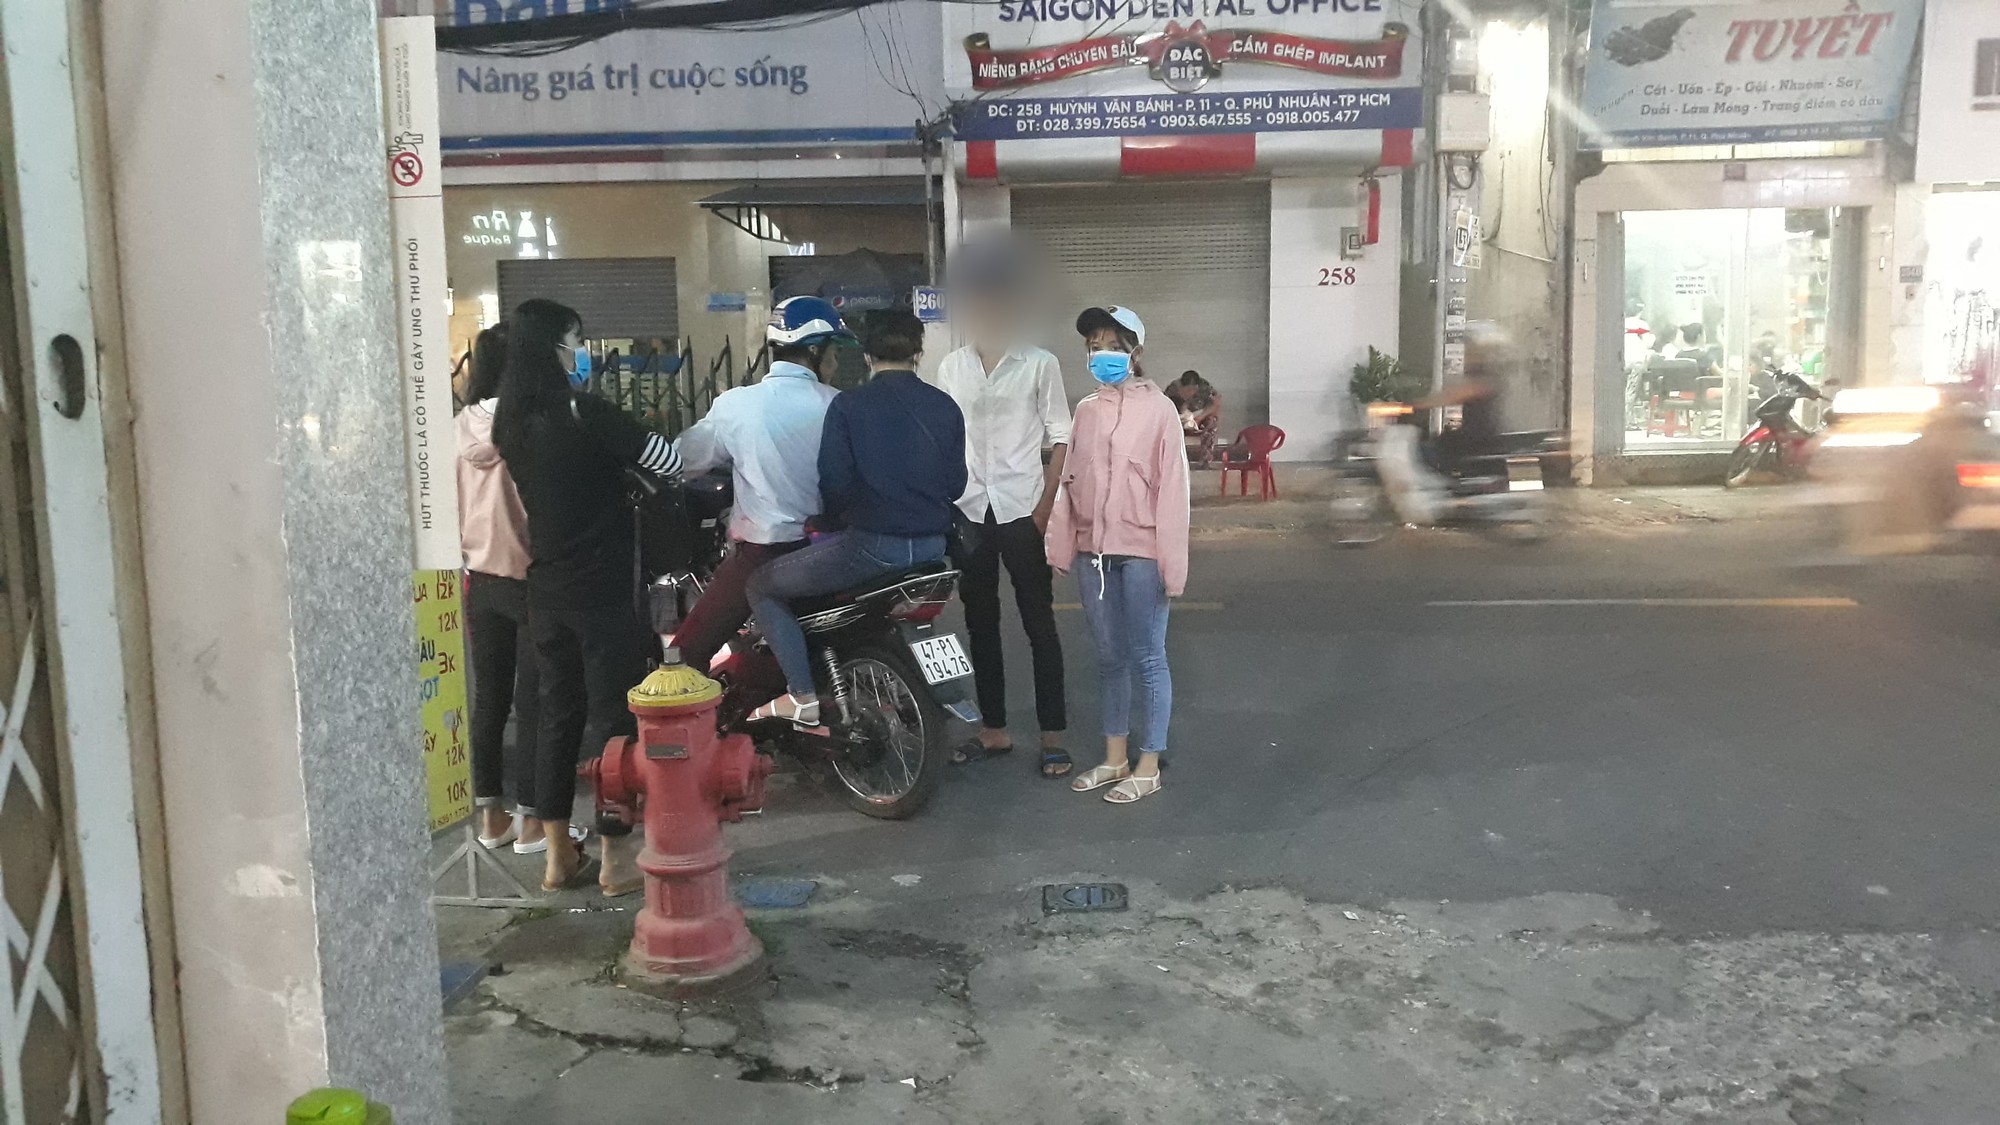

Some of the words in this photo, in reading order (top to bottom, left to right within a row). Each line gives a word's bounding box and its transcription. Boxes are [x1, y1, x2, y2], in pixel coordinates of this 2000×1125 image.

[1111, 40, 1137, 59] SÂU
[1170, 46, 1203, 63] ĐẶC
[1273, 44, 1315, 61] GHÉP
[1318, 52, 1388, 69] IMPLANT
[457, 66, 540, 101] Nâng
[548, 63, 595, 101] giá
[603, 62, 639, 96] trị
[649, 62, 726, 95] cuộc
[734, 54, 809, 95] sống
[1170, 64, 1204, 81] BIỆT
[988, 104, 1012, 117] ĐC:
[1017, 103, 1042, 116] 258
[1050, 99, 1097, 115] HUỲNH
[1104, 98, 1131, 113] VĂN
[1136, 97, 1174, 113] BÁNH
[1200, 98, 1210, 110] 11
[1244, 94, 1273, 109] PHÚ
[1360, 93, 1391, 106] HCM
[1016, 119, 1040, 132] ĐT:
[1043, 116, 1146, 131] 028.399.75654
[1160, 112, 1252, 128] 0903.647.555
[1266, 110, 1360, 125] 0918.005.477
[1318, 266, 1356, 286] 258
[918, 293, 946, 311] 260
[410, 307, 422, 341] UNG
[412, 342, 425, 371] GÂY
[414, 404, 426, 427] CÓ
[417, 452, 431, 498] THUỐC
[438, 609, 459, 632] 12K
[419, 635, 435, 663] ÂU
[437, 651, 456, 675] 3K
[925, 655, 970, 681] 194.76
[446, 742, 466, 767] 12K
[447, 779, 468, 804] 10K
